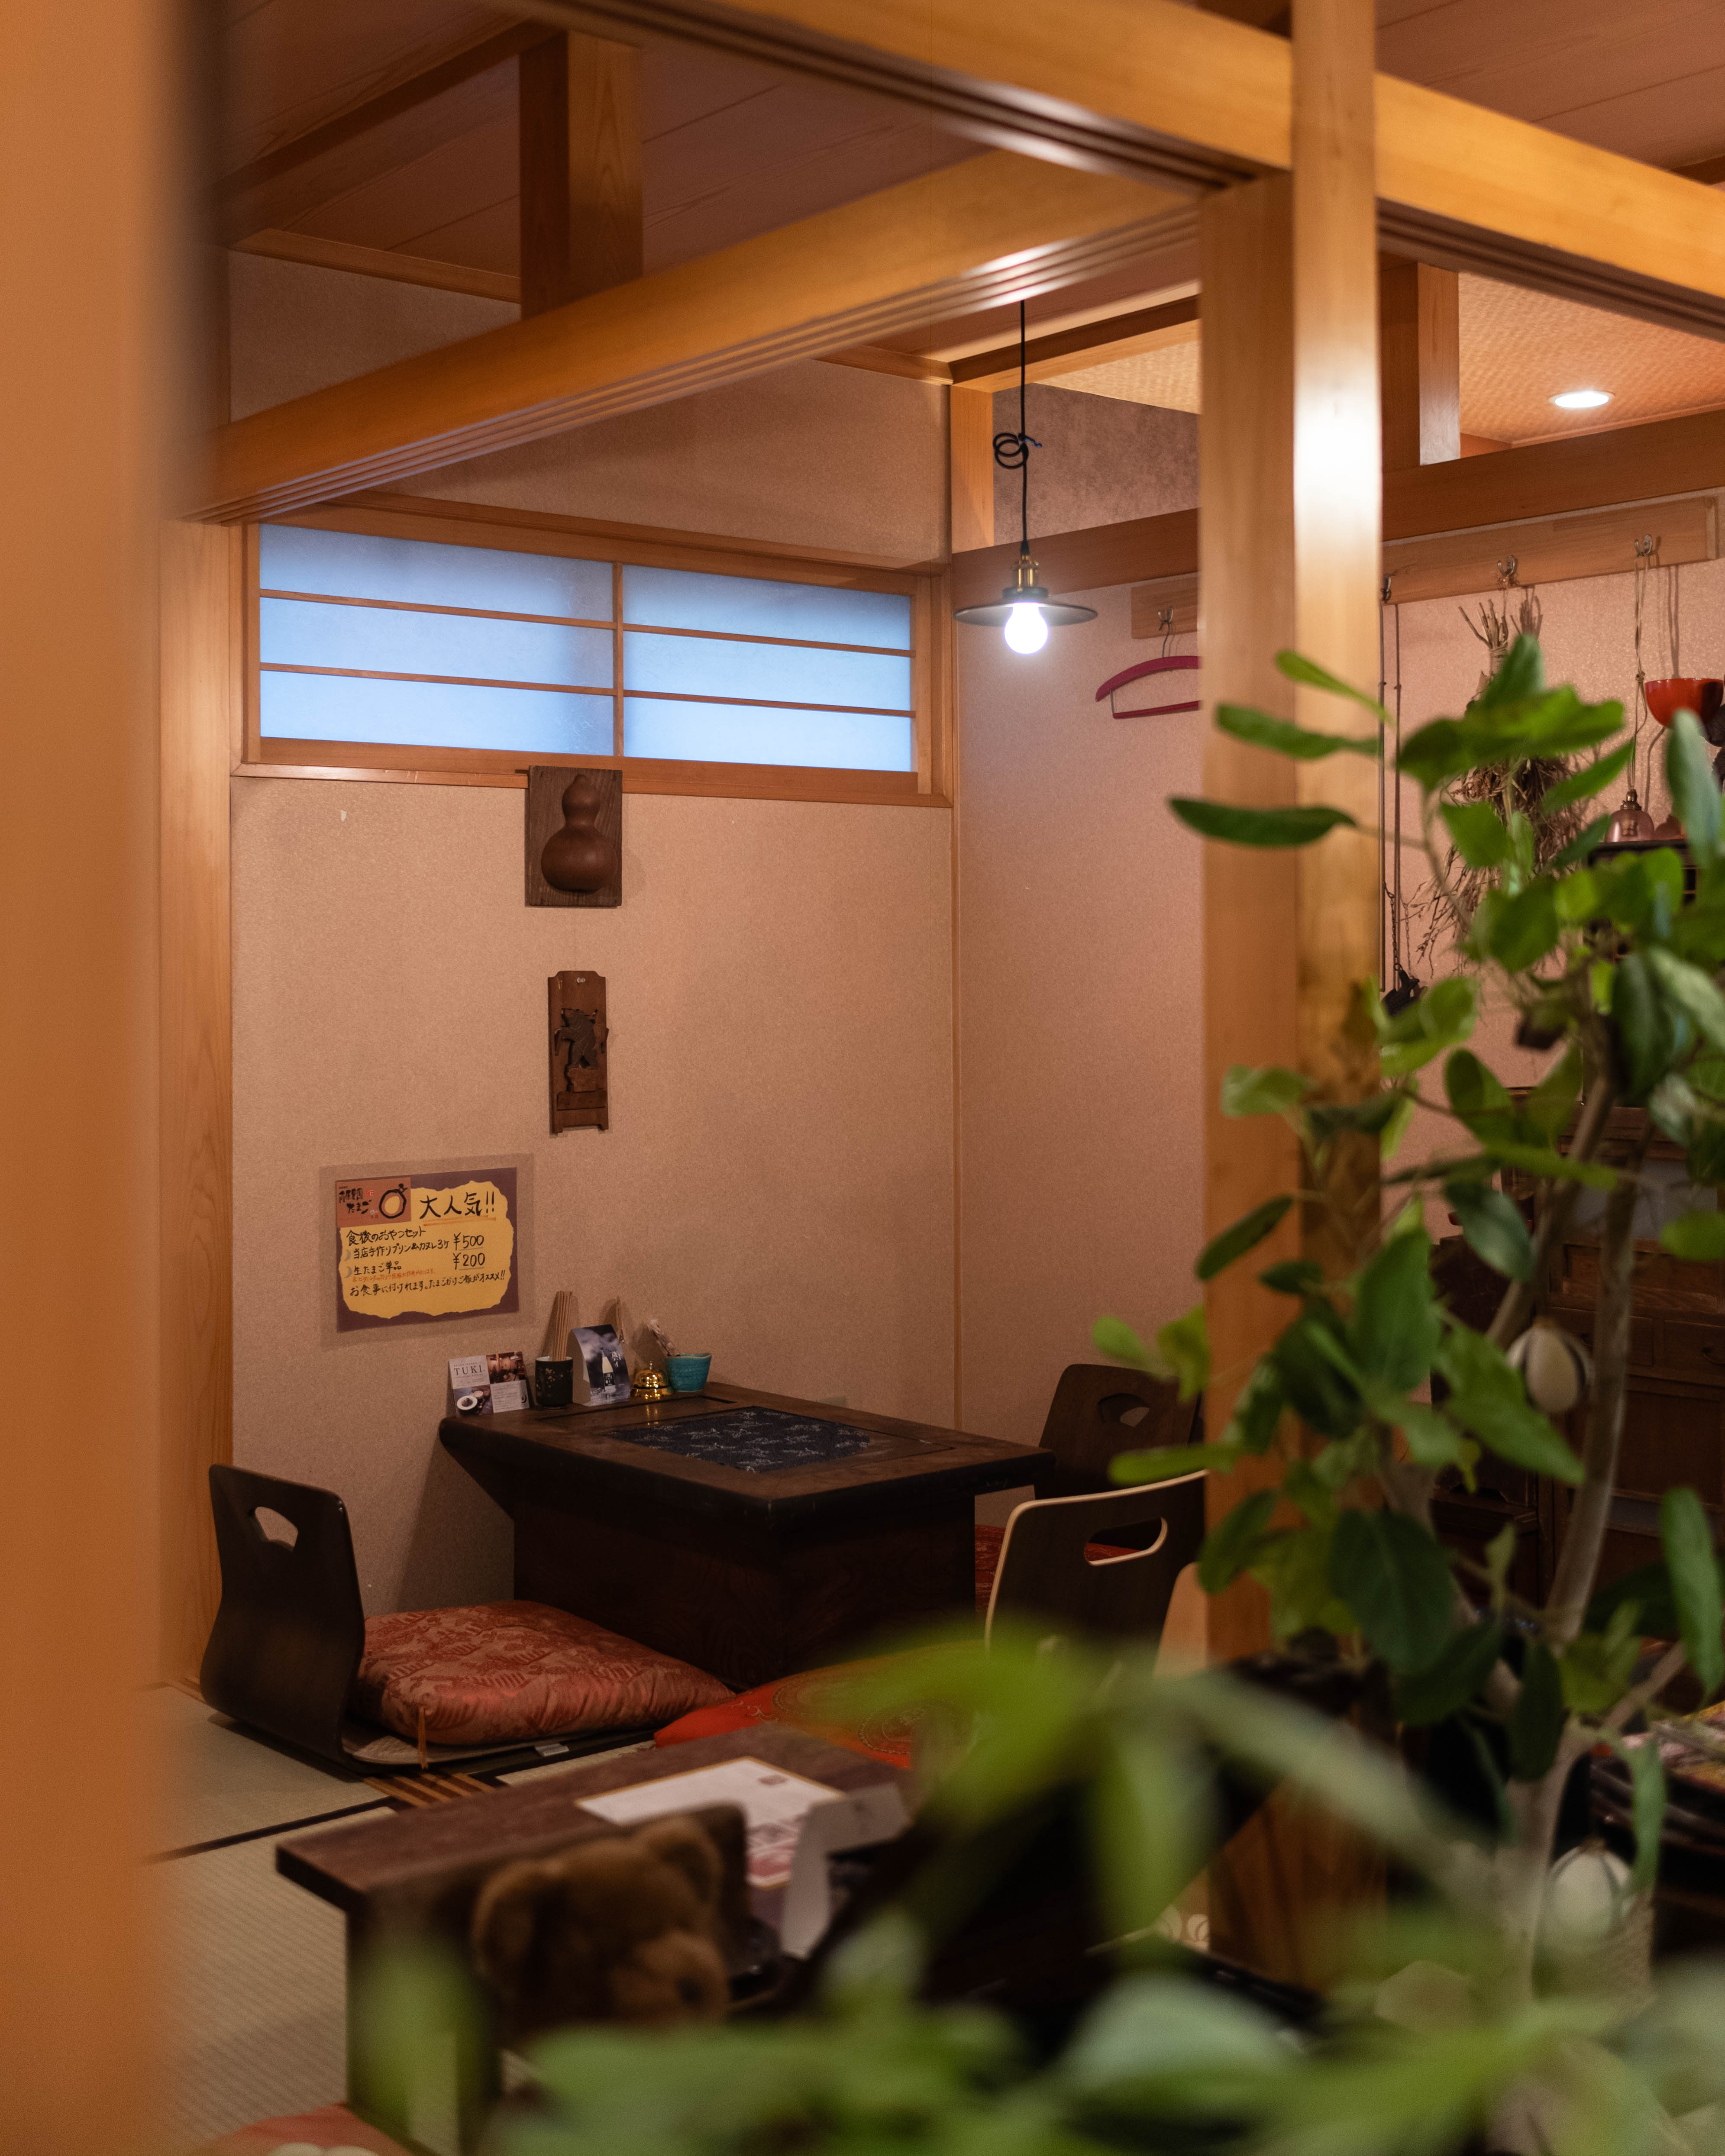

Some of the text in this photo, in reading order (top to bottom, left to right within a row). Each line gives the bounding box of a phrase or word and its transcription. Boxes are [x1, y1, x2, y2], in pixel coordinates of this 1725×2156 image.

[346, 1226, 426, 1246] 食後のおやつセット
[453, 1232, 485, 1250] ¥500
[354, 1252, 485, 1275] 生たまご単品 ¥200
[454, 1365, 482, 1375] TUKI
